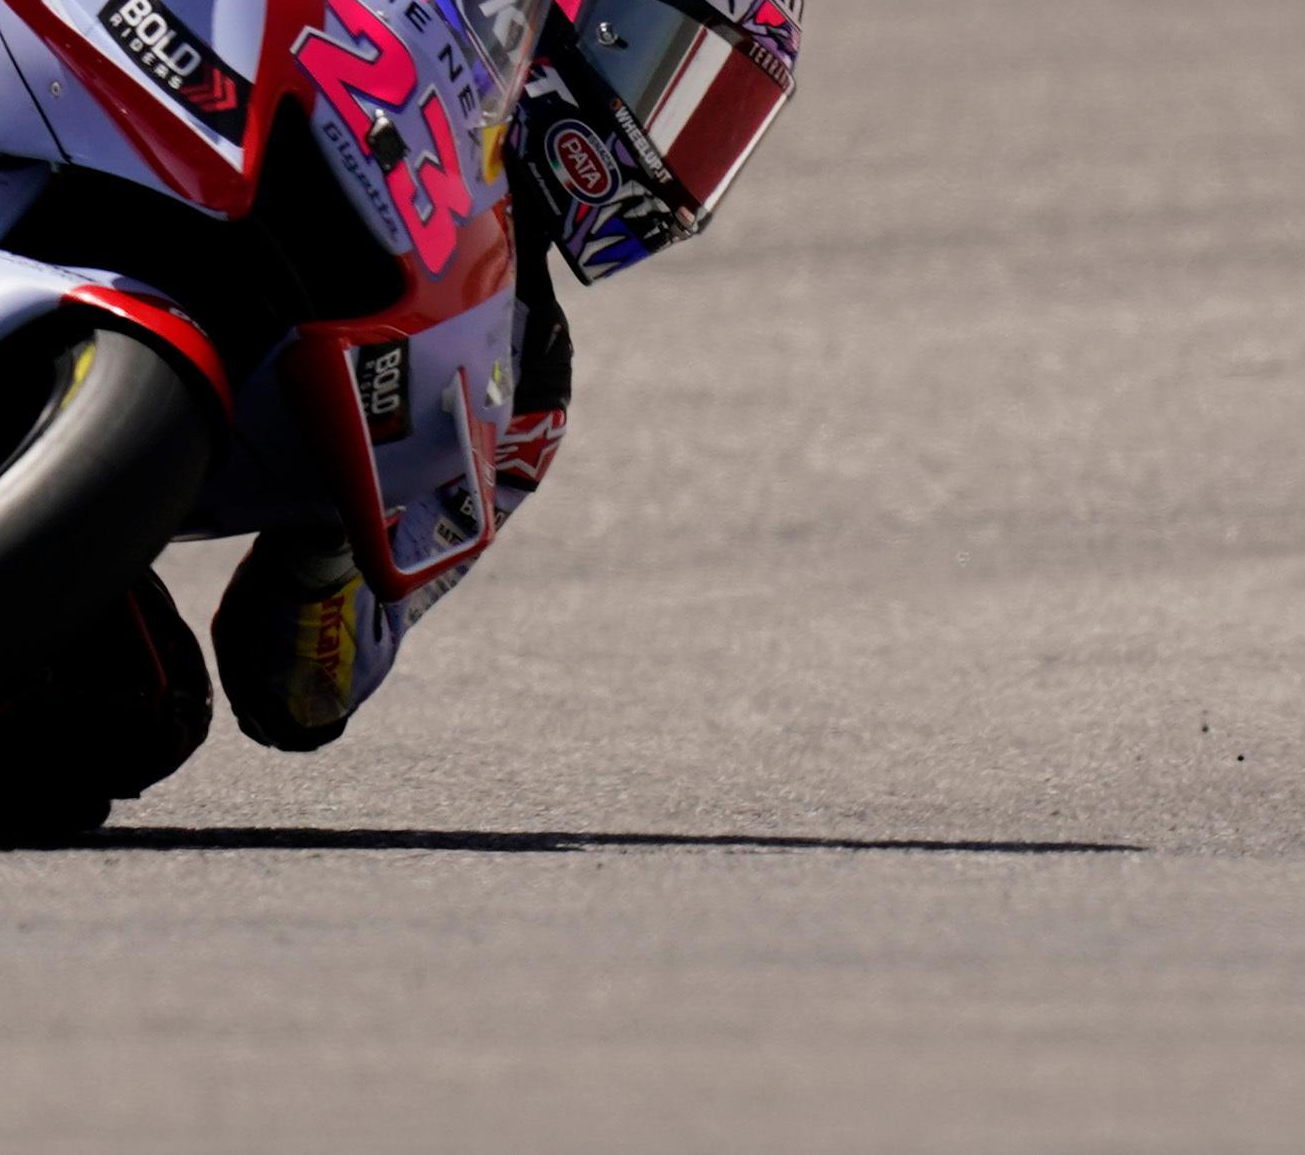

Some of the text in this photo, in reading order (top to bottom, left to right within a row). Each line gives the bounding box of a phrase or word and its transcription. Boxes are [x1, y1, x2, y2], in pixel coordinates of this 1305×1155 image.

[109, 13, 183, 90] RIDERS
[562, 138, 602, 189] PATA
[371, 347, 402, 415] BOLD
